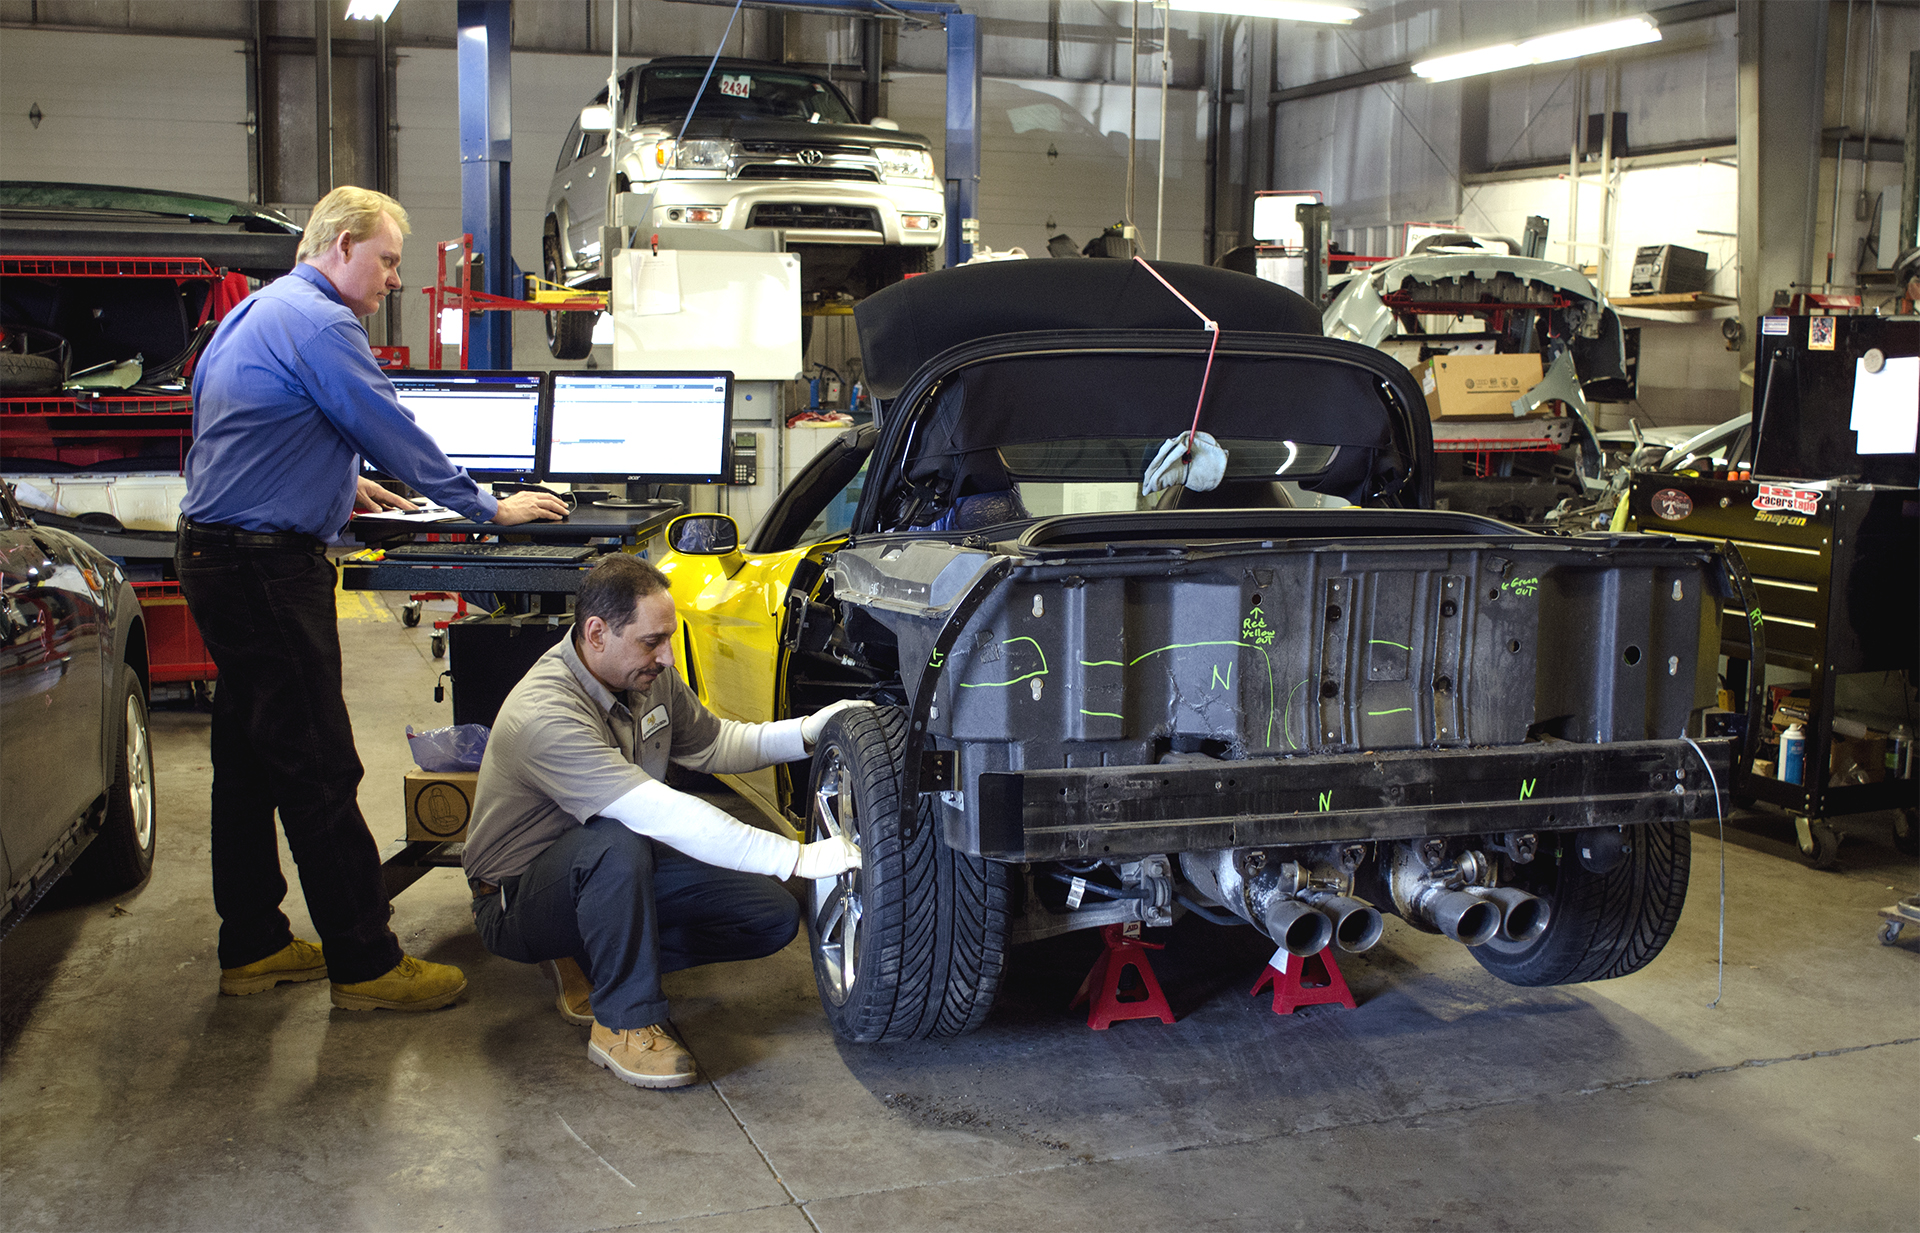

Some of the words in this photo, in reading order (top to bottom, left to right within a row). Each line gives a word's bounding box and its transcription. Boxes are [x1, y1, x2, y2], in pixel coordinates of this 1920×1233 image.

[723, 81, 749, 97] 2434
[1243, 618, 1267, 629] Red
[1210, 661, 1233, 690] N
[1318, 789, 1332, 813] N
[1519, 777, 1536, 801] N
